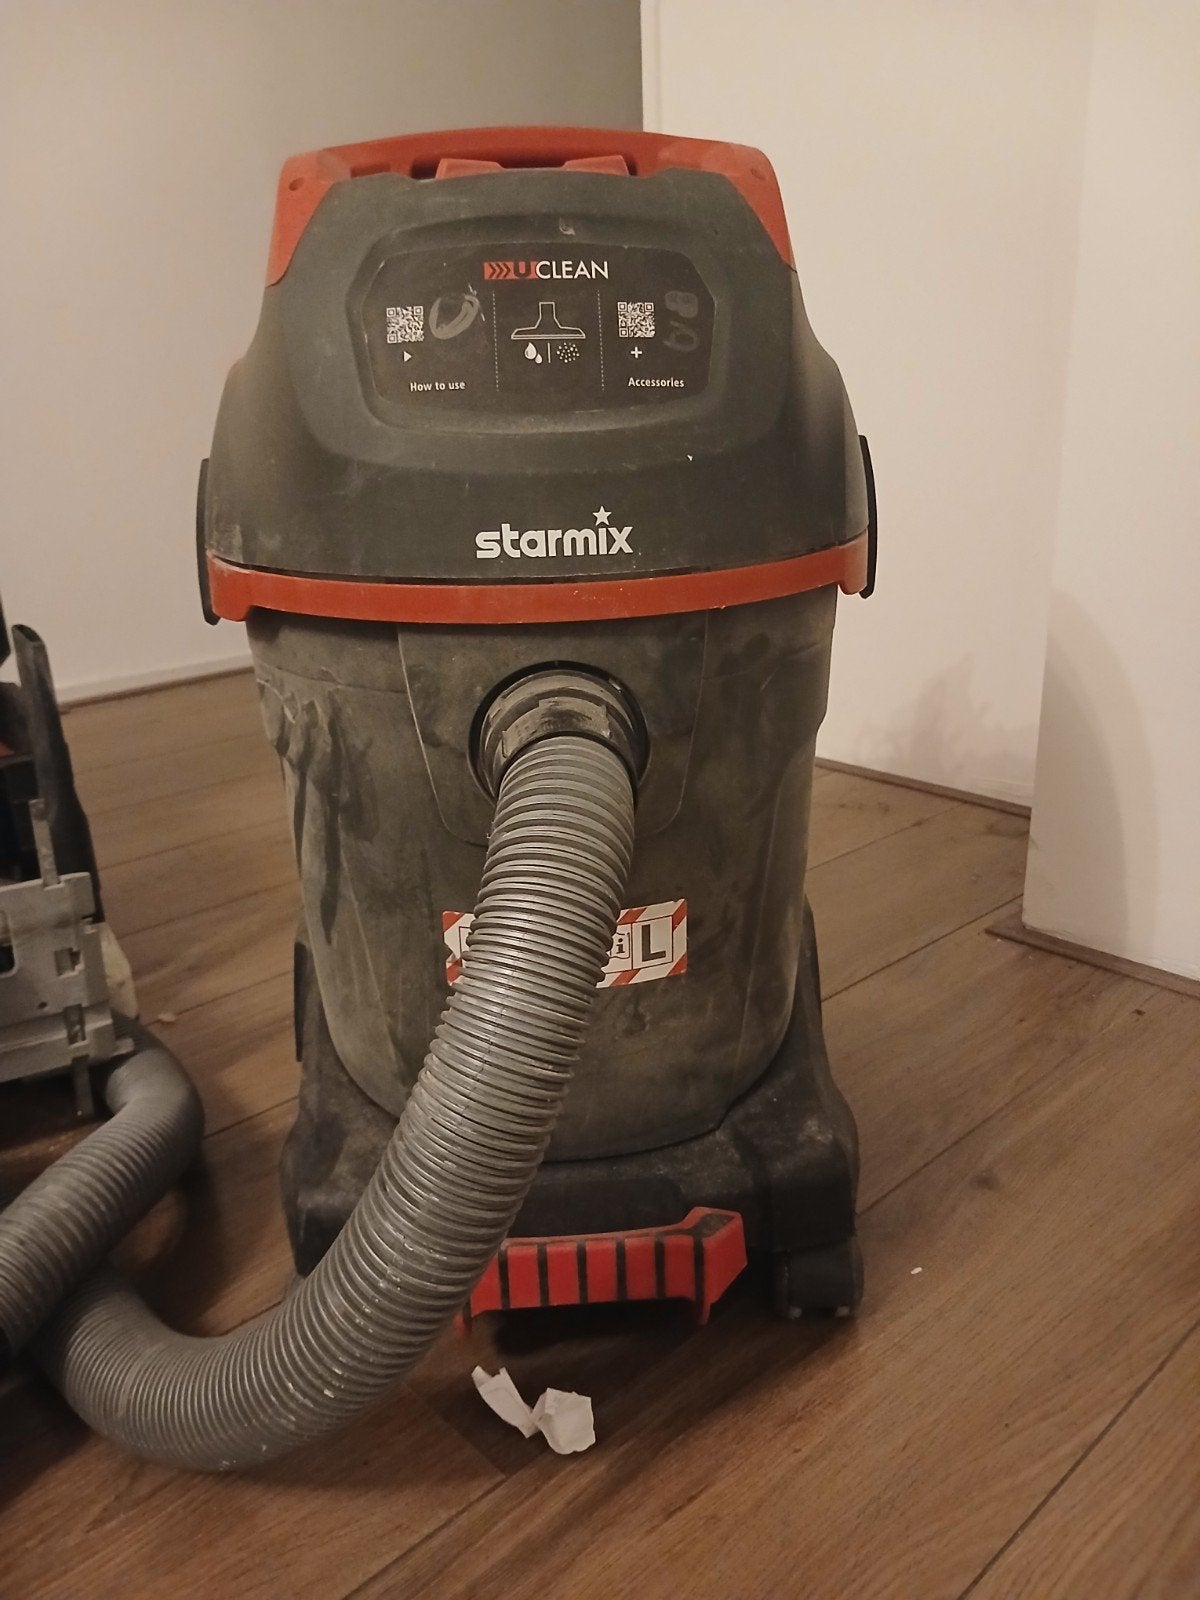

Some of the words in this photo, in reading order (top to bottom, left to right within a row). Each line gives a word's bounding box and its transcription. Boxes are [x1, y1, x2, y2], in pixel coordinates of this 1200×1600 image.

[513, 260, 609, 280] UCLEAN
[410, 381, 432, 392] How
[435, 381, 446, 391] to
[448, 381, 466, 390] use
[628, 376, 685, 388] Accessories
[475, 506, 634, 559] starmix
[642, 924, 666, 962] L
